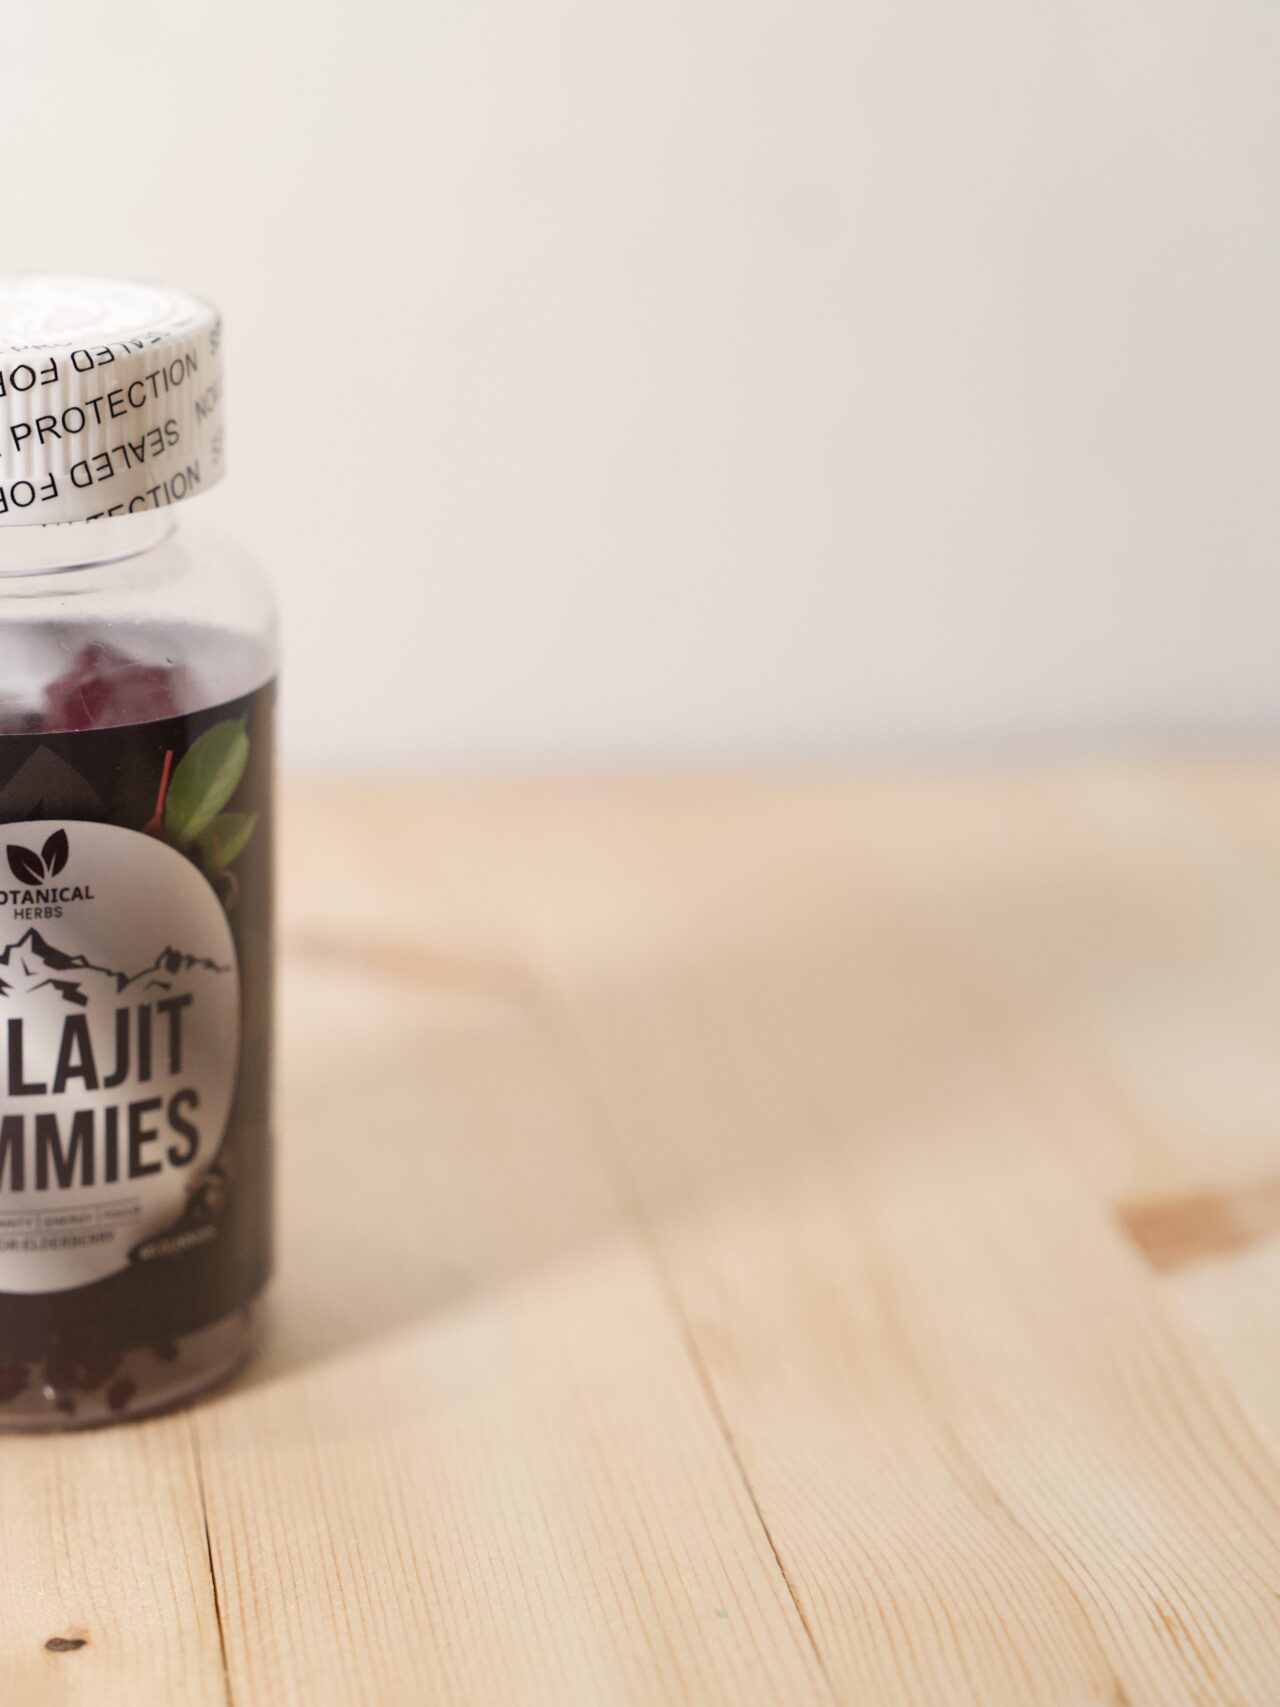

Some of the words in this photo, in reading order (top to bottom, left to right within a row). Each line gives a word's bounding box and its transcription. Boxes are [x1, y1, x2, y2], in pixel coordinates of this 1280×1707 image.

[10, 348, 198, 452] PROTECTION
[70, 419, 180, 489] SEALED
[13, 906, 63, 920] HERBS
